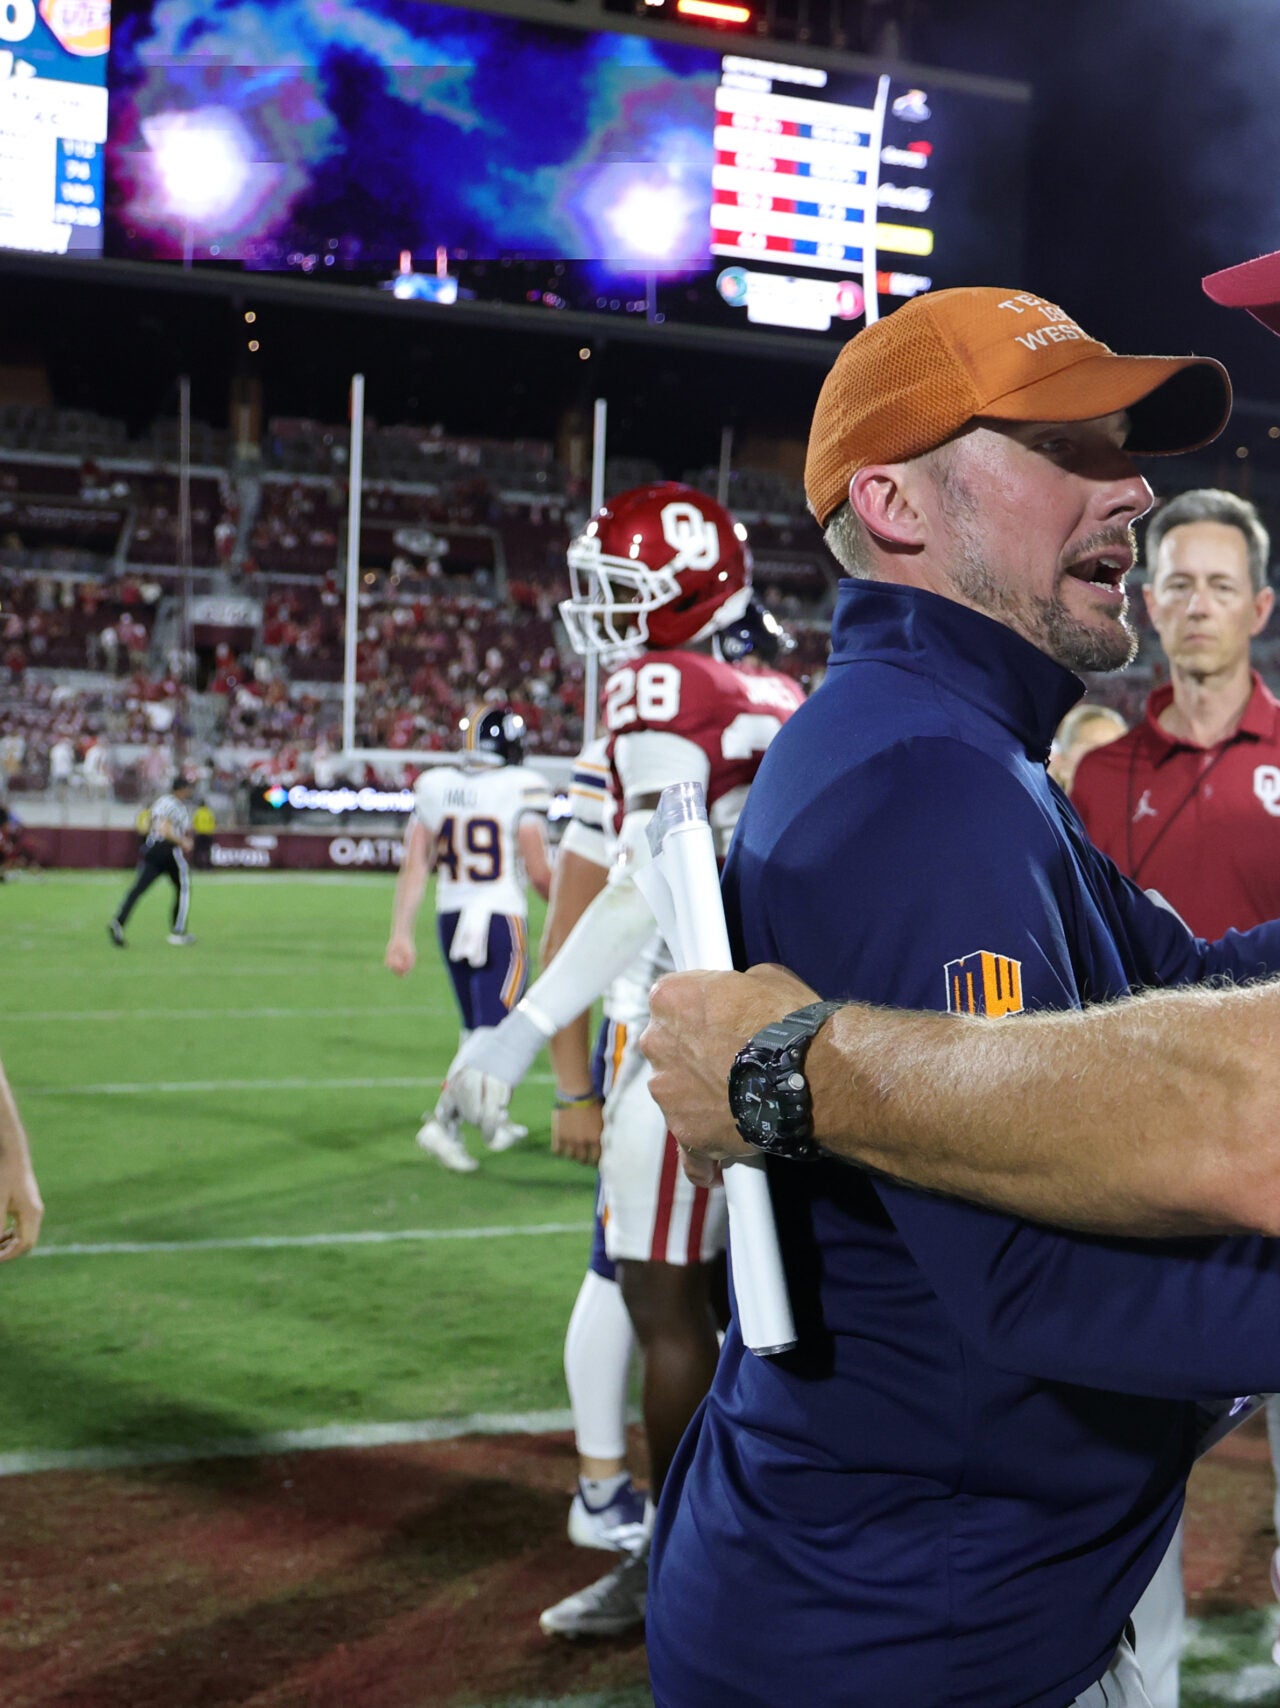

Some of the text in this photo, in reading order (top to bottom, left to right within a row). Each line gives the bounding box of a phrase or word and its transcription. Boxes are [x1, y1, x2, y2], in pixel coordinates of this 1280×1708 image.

[998, 294, 1042, 313] TE
[661, 502, 719, 570] OU
[605, 663, 681, 731] 28
[432, 815, 502, 882] 49
